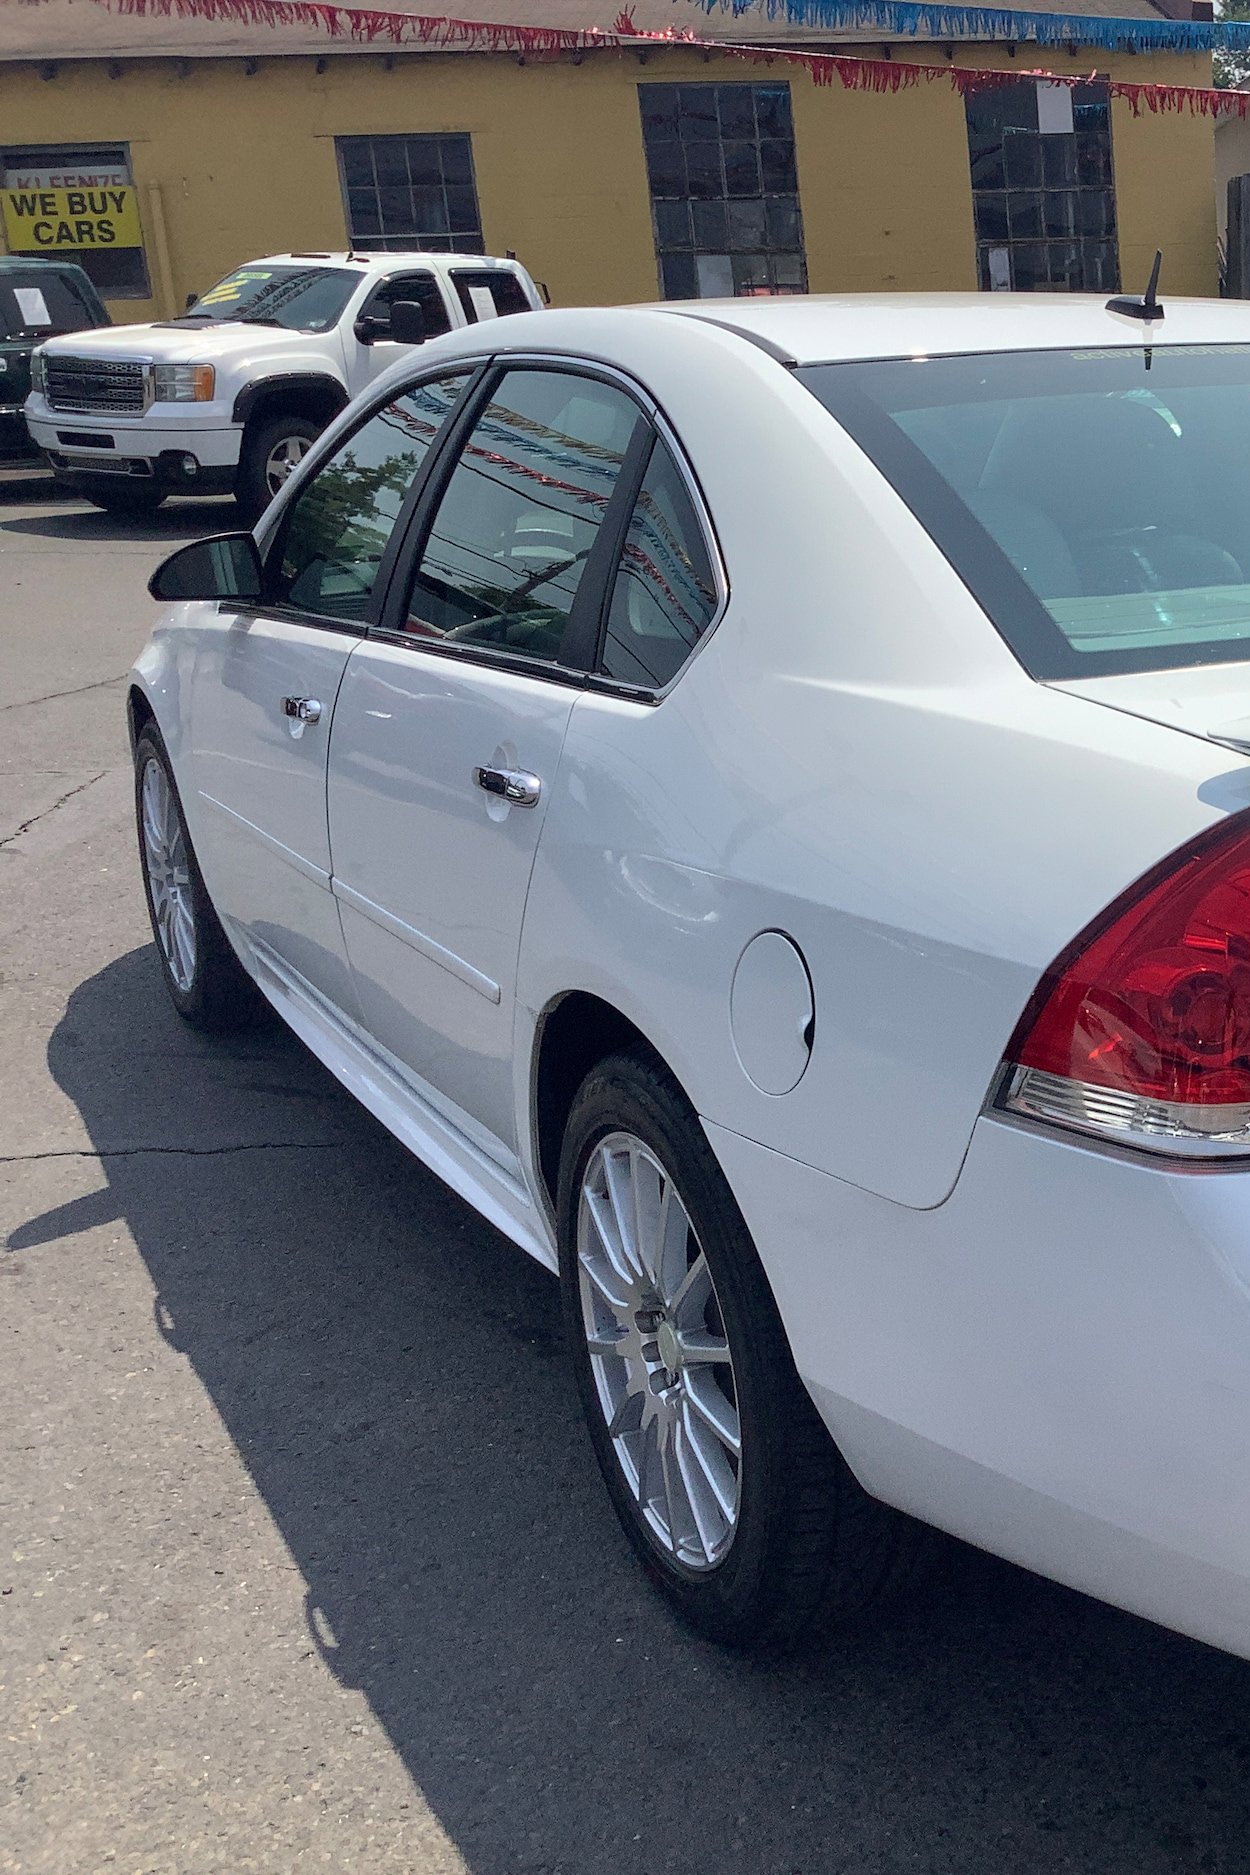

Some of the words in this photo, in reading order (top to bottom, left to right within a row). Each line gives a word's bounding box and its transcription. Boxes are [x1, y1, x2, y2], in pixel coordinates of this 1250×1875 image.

[9, 193, 59, 217] WE
[66, 191, 126, 215] BUY
[32, 219, 116, 245] CARS
